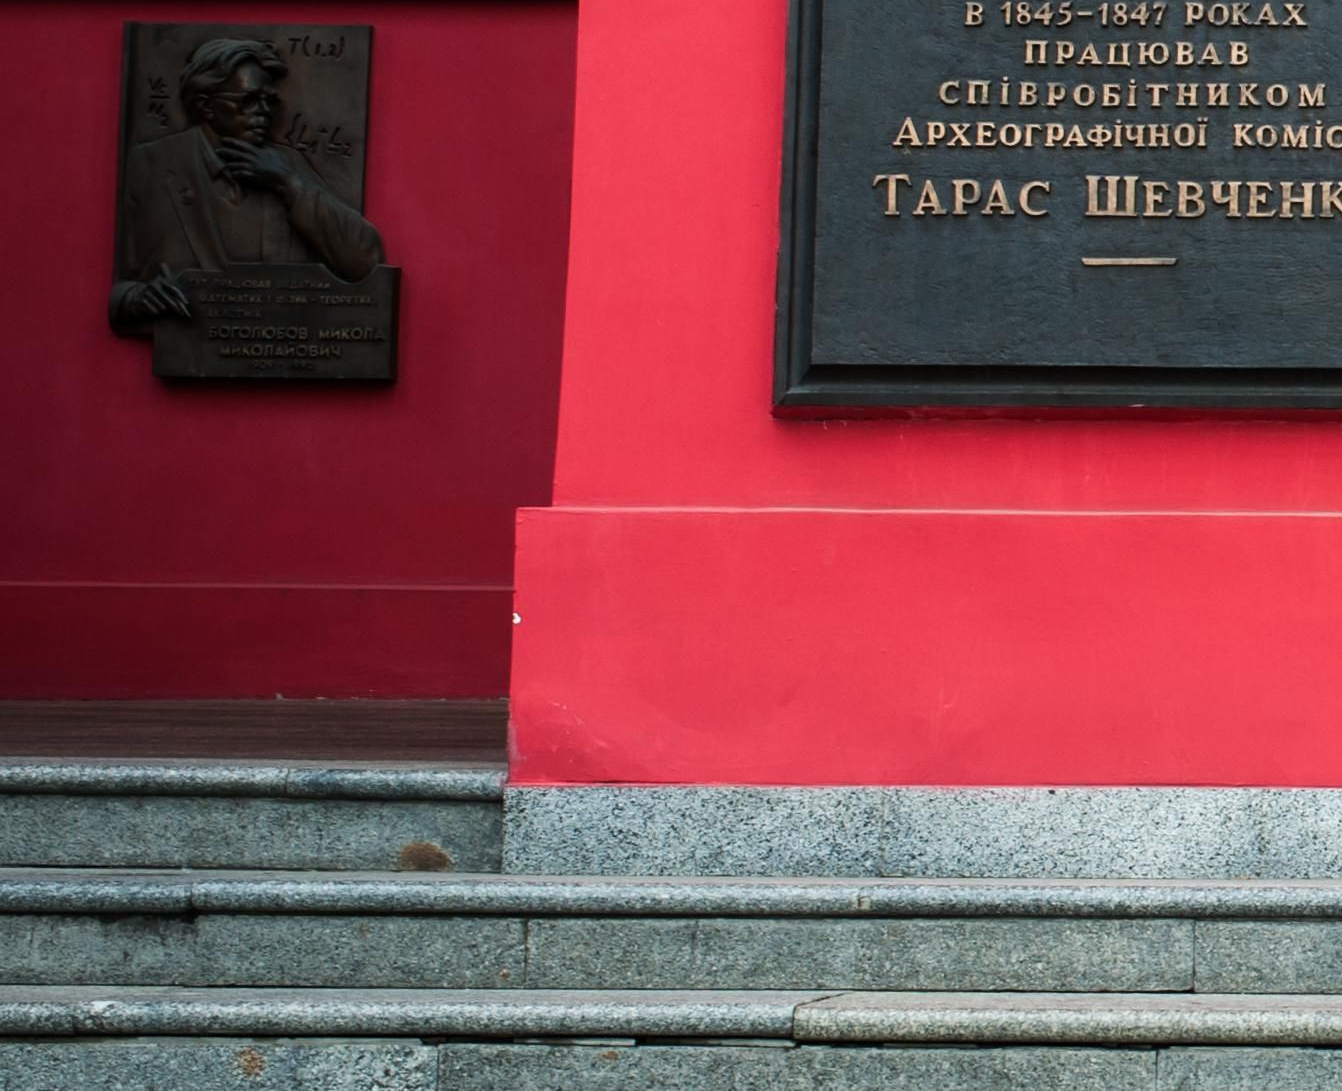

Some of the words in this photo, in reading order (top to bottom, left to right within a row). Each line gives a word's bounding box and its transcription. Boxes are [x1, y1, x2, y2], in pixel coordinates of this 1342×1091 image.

[966, 3, 984, 27] В
[1186, 3, 1307, 27] РОКАХ
[1025, 40, 1250, 67] ПРАЦЮВАВ
[939, 77, 1326, 108] СПІВРОБІТНИКОМ
[207, 325, 310, 340] БОГОЛЮБОВ
[318, 326, 385, 341] МИКОЛА
[219, 340, 342, 358] МИКОЛАЙОВИЧ
